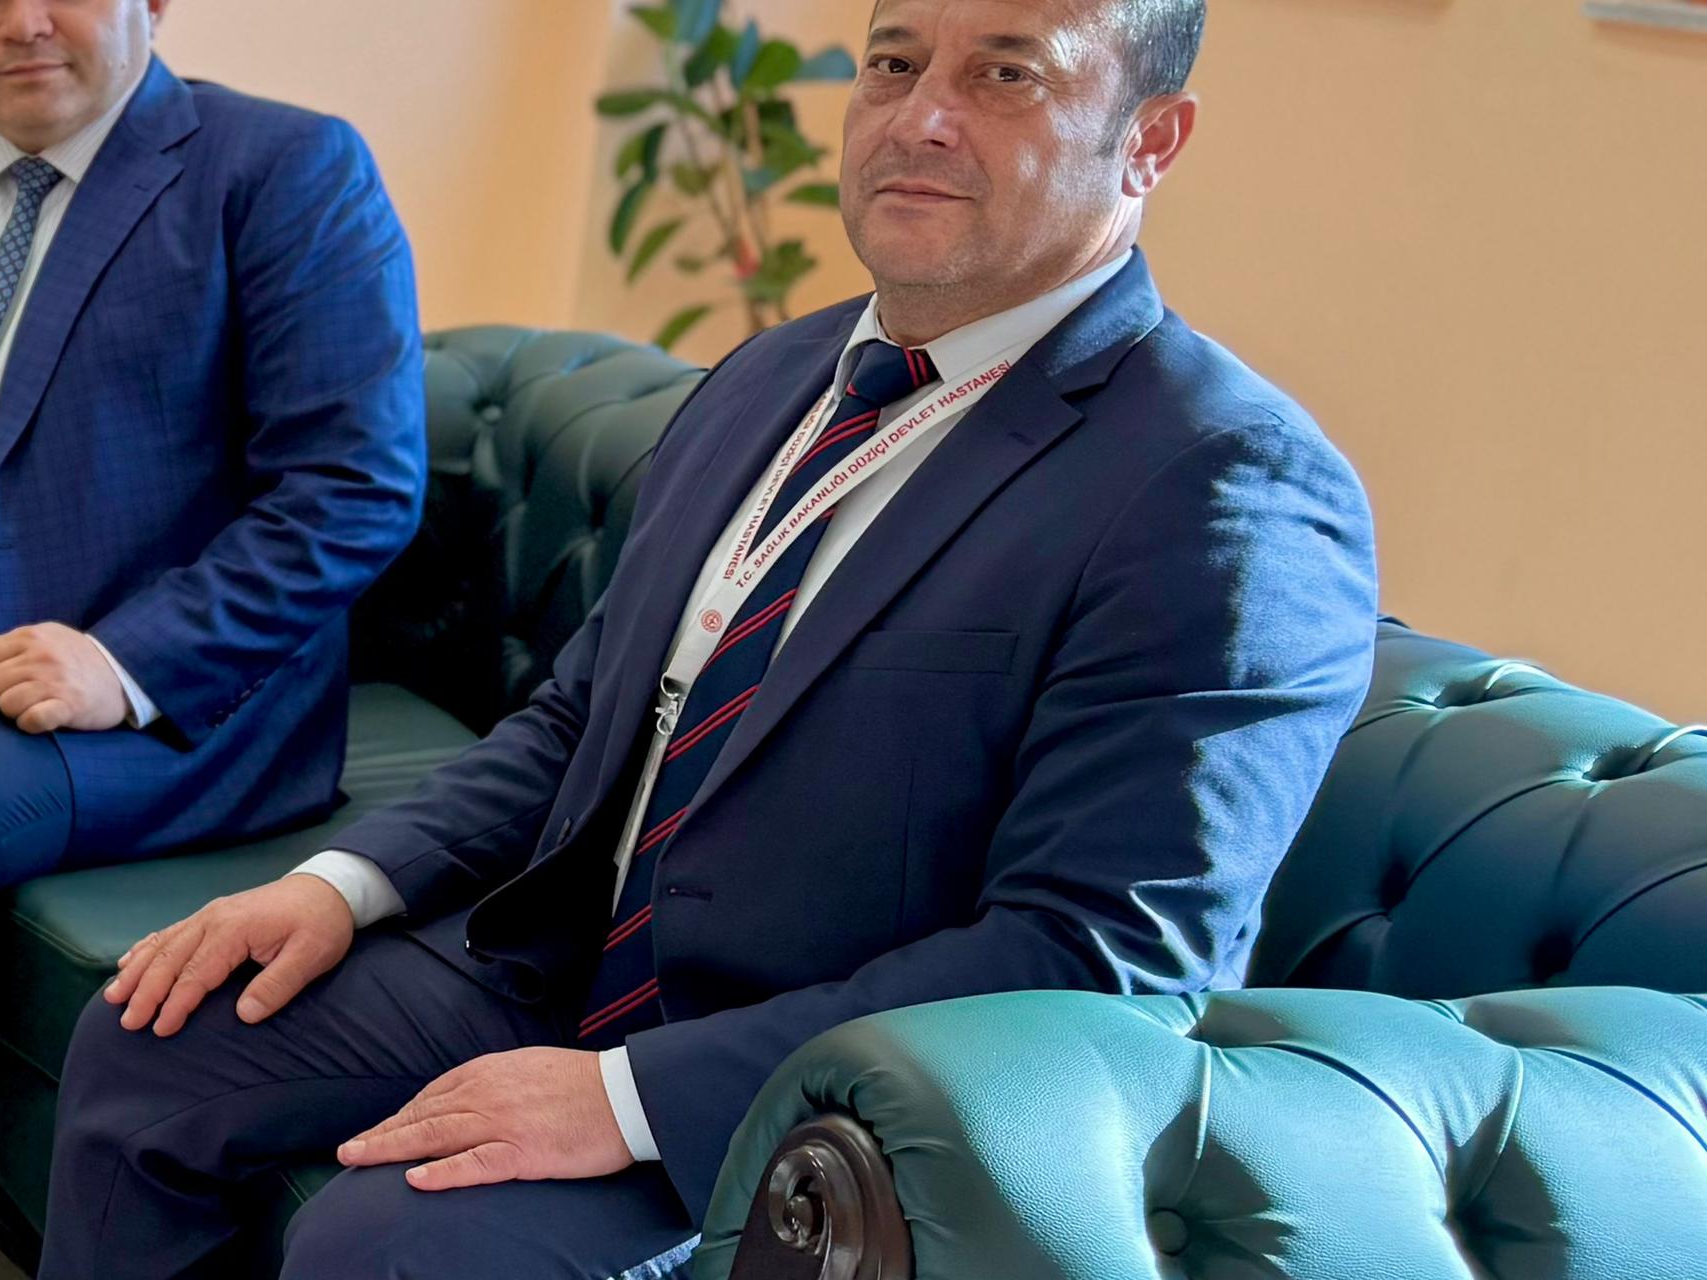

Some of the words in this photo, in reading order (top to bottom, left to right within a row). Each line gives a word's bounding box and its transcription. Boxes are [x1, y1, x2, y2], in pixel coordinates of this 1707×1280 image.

[735, 569, 756, 588] T.C.
[888, 403, 936, 443] DEVLET
[756, 469, 784, 512] DEVLET
